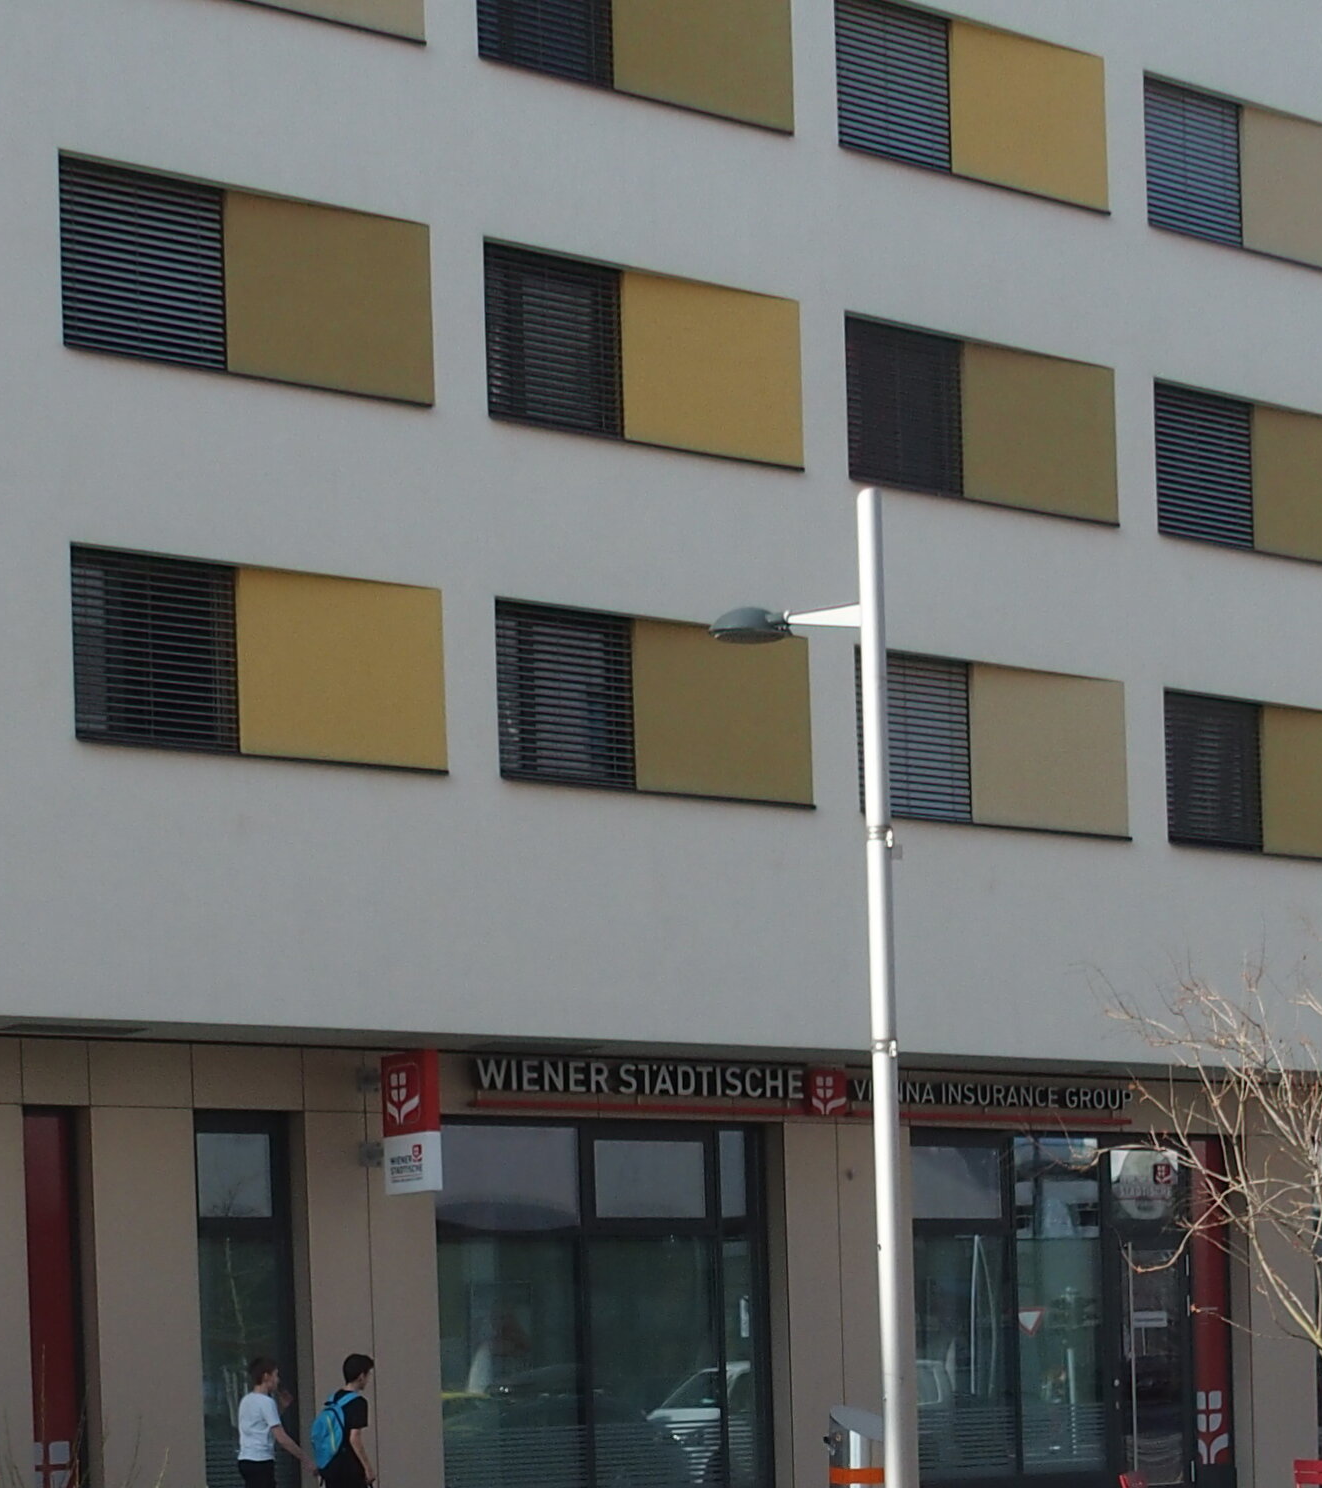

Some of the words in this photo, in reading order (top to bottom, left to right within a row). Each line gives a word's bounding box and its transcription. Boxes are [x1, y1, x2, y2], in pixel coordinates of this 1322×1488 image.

[477, 1058, 610, 1093] WIENER
[618, 1063, 805, 1100] STÄDTISCHE
[853, 1079, 935, 1104] VINA
[941, 1082, 1060, 1109] INSURANCE
[1065, 1087, 1134, 1110] GROUP
